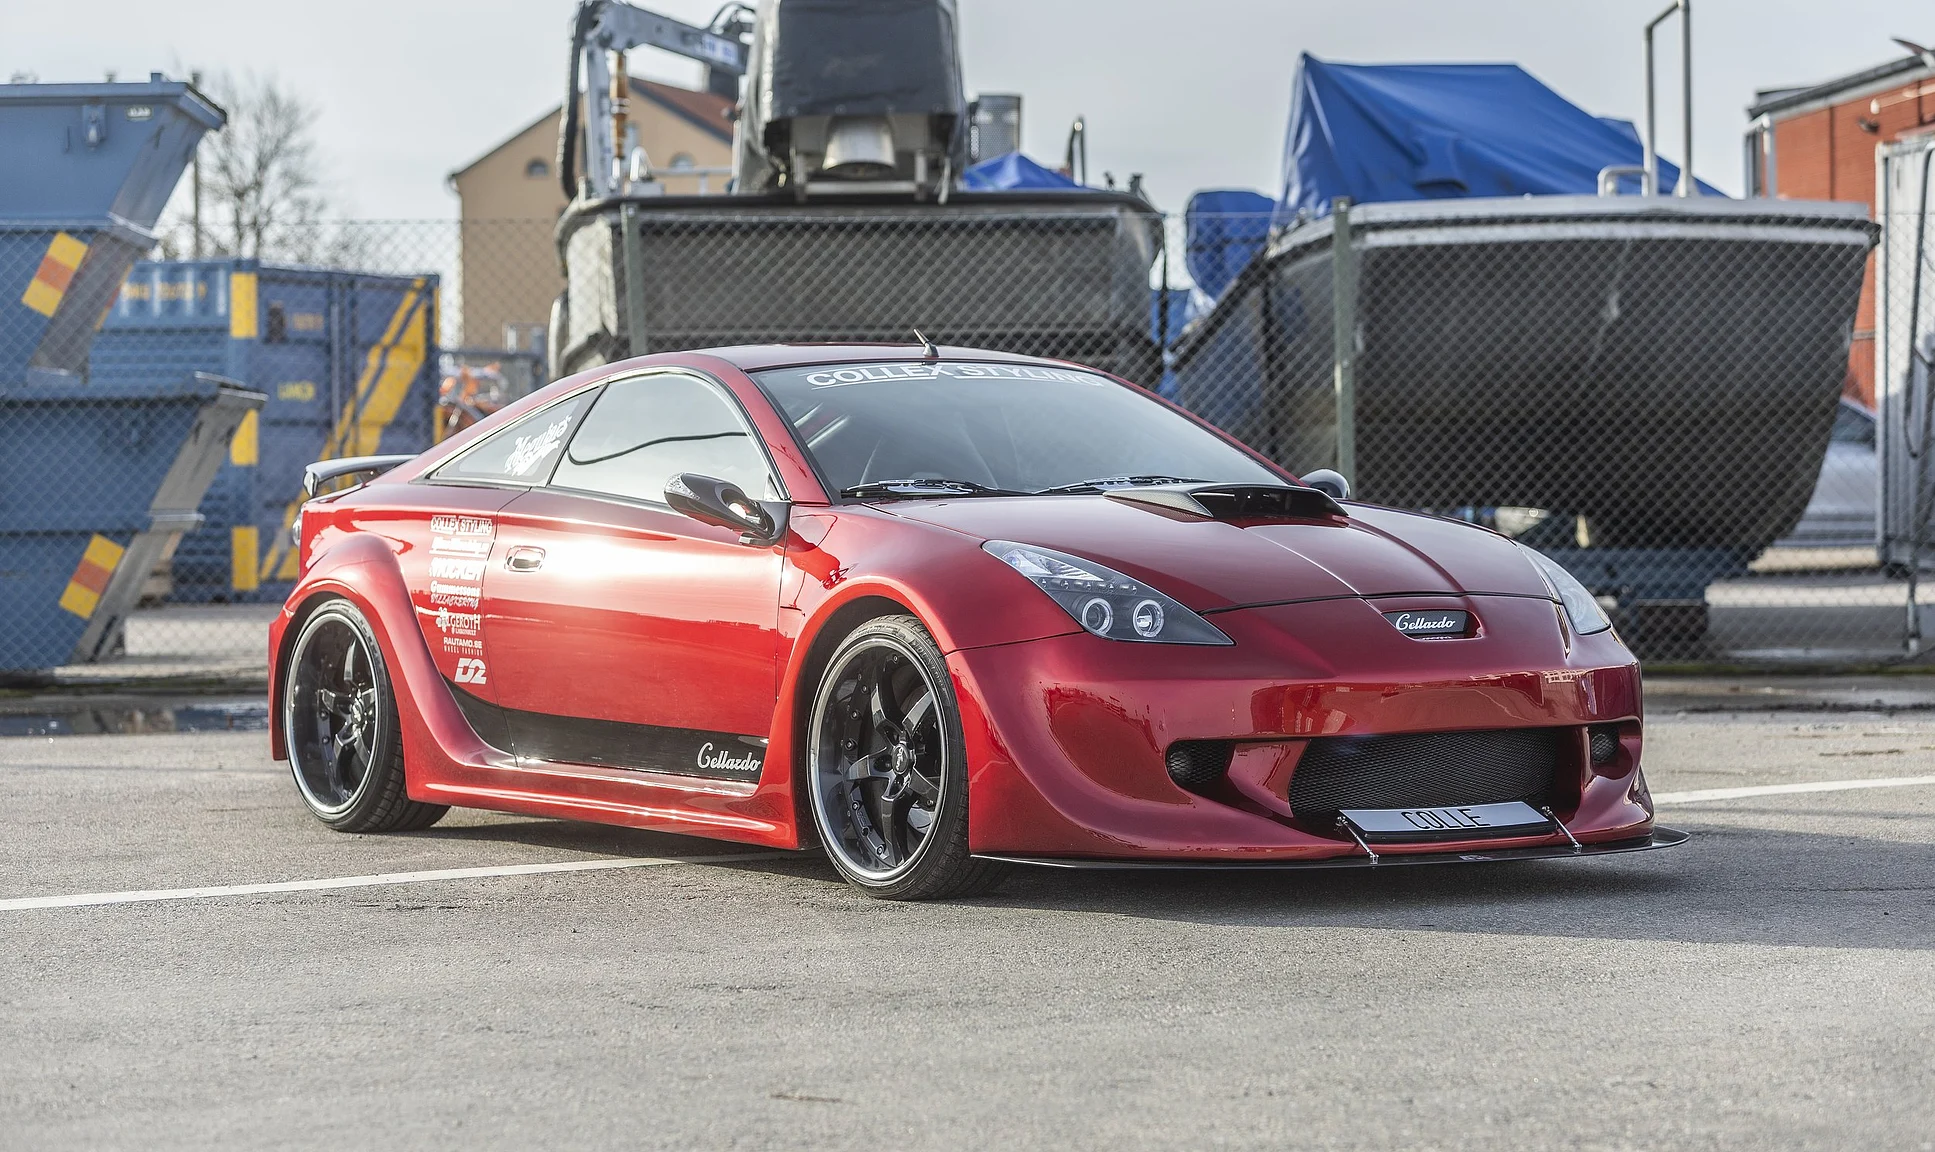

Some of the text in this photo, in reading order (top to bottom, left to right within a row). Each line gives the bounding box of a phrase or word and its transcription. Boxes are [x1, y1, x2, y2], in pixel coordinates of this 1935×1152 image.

[806, 365, 1104, 388] COLLEX STYLING
[430, 516, 493, 535] COLLEX STYLING
[443, 636, 483, 649] RAUTAMO.SE
[454, 657, 487, 685] D2
[1400, 808, 1491, 830] COLLE
